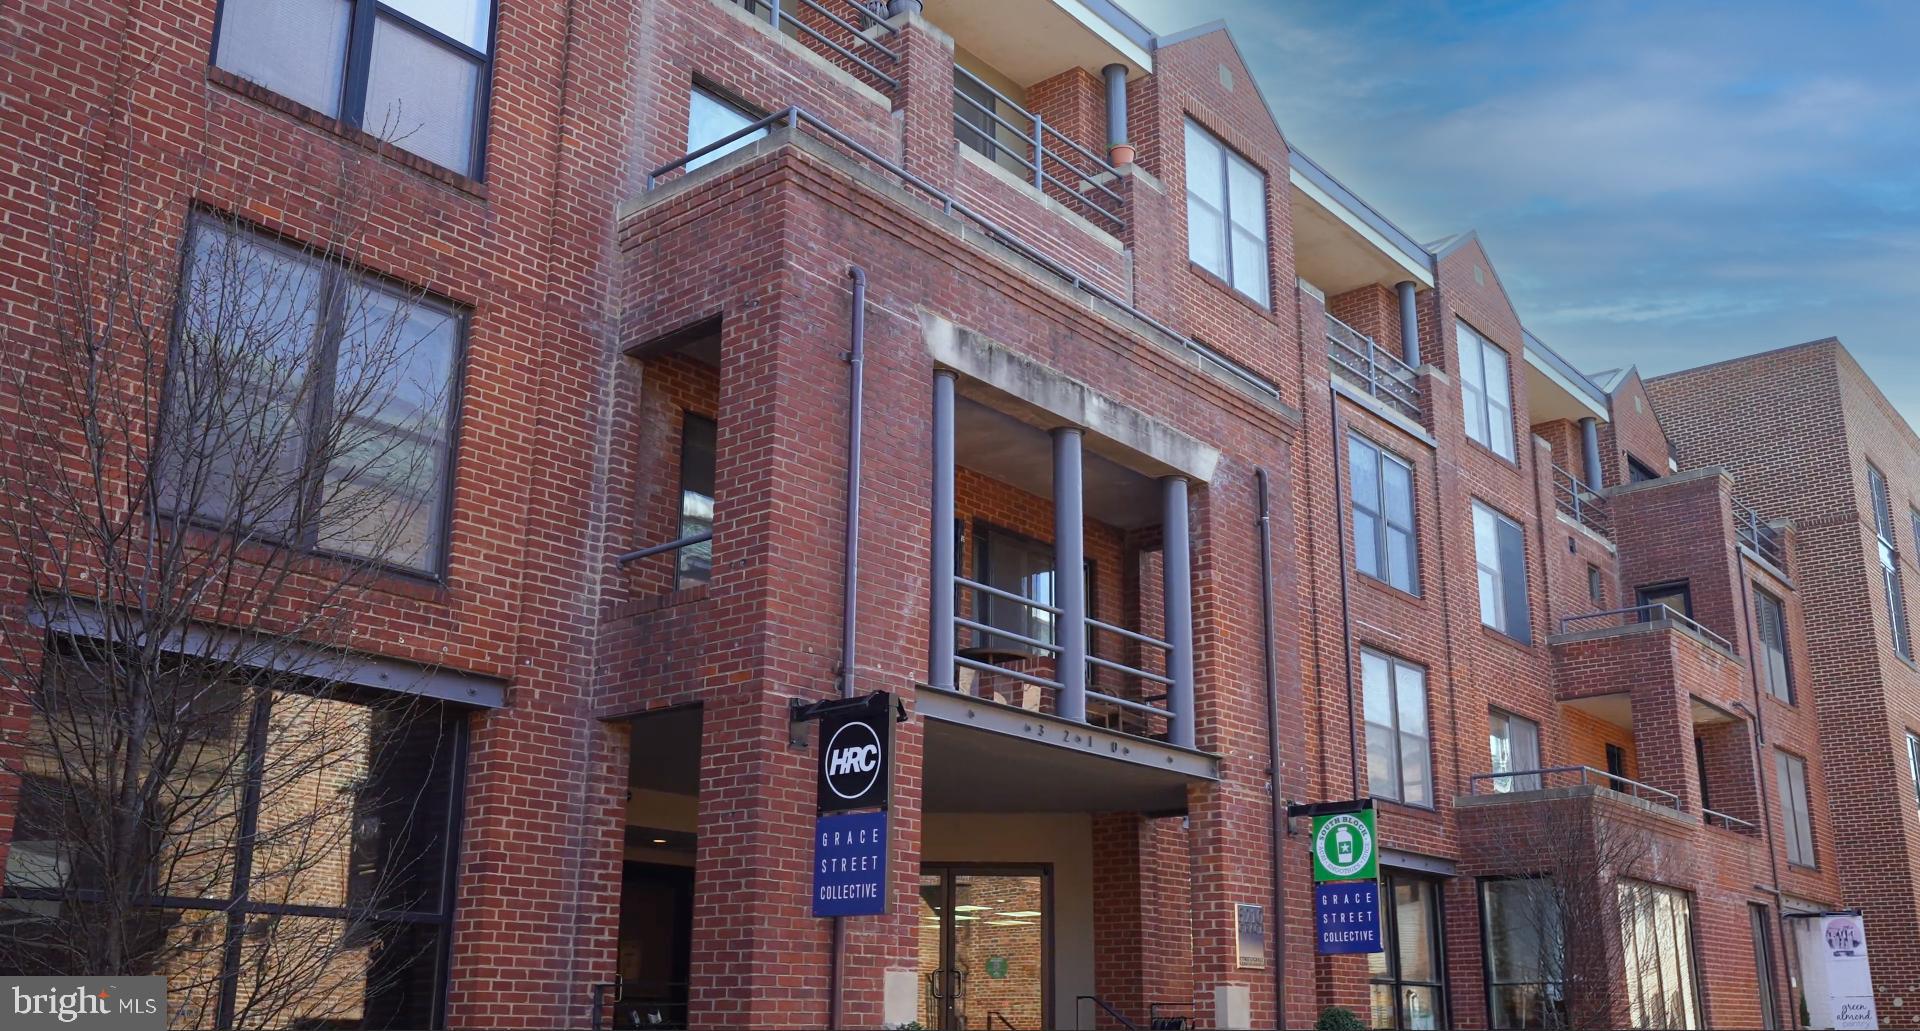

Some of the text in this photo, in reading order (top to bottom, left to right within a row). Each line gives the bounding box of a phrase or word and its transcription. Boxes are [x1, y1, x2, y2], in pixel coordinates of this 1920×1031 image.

[829, 744, 878, 776] HRC
[1319, 816, 1368, 841] SOUTH BLOCK
[822, 828, 879, 847] GRACE
[821, 855, 878, 873] STREET
[820, 883, 877, 900] COLLECTIVE
[1322, 892, 1372, 905] GRACE
[1323, 911, 1372, 924] STREET
[1323, 930, 1374, 943] COLLECTIVE
[1836, 1010, 1872, 1020] almond
[1841, 1003, 1867, 1016] green
